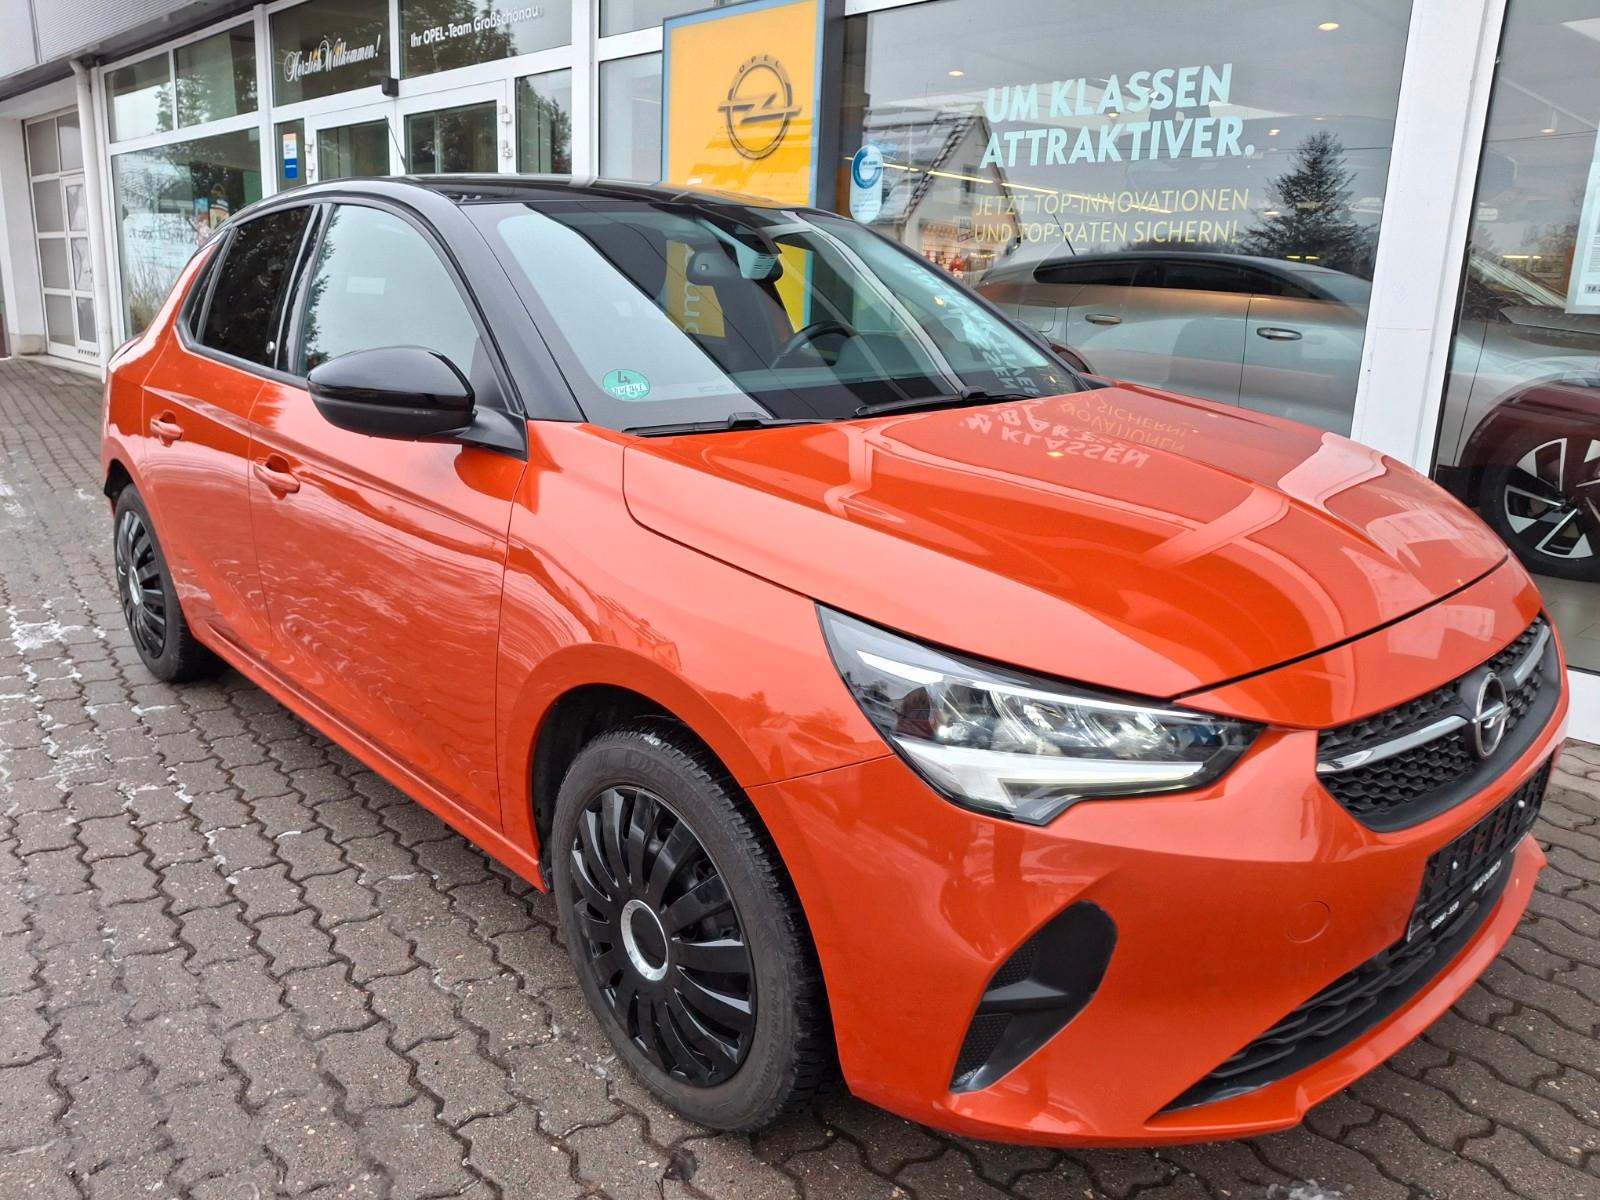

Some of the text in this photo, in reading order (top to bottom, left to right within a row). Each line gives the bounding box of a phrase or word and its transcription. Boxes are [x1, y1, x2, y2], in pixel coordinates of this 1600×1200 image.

[410, 5, 538, 47] Ihr OPEL-Team Großschönau
[739, 54, 780, 73] OPEL
[985, 62, 1233, 123] UM KLASSEN
[980, 116, 1255, 169] ATTRAKTIVER.
[975, 188, 1249, 217] JETZT TOP-INNOVATIONEN
[974, 219, 1238, 244] UND TOP-RATEN SICHERN!
